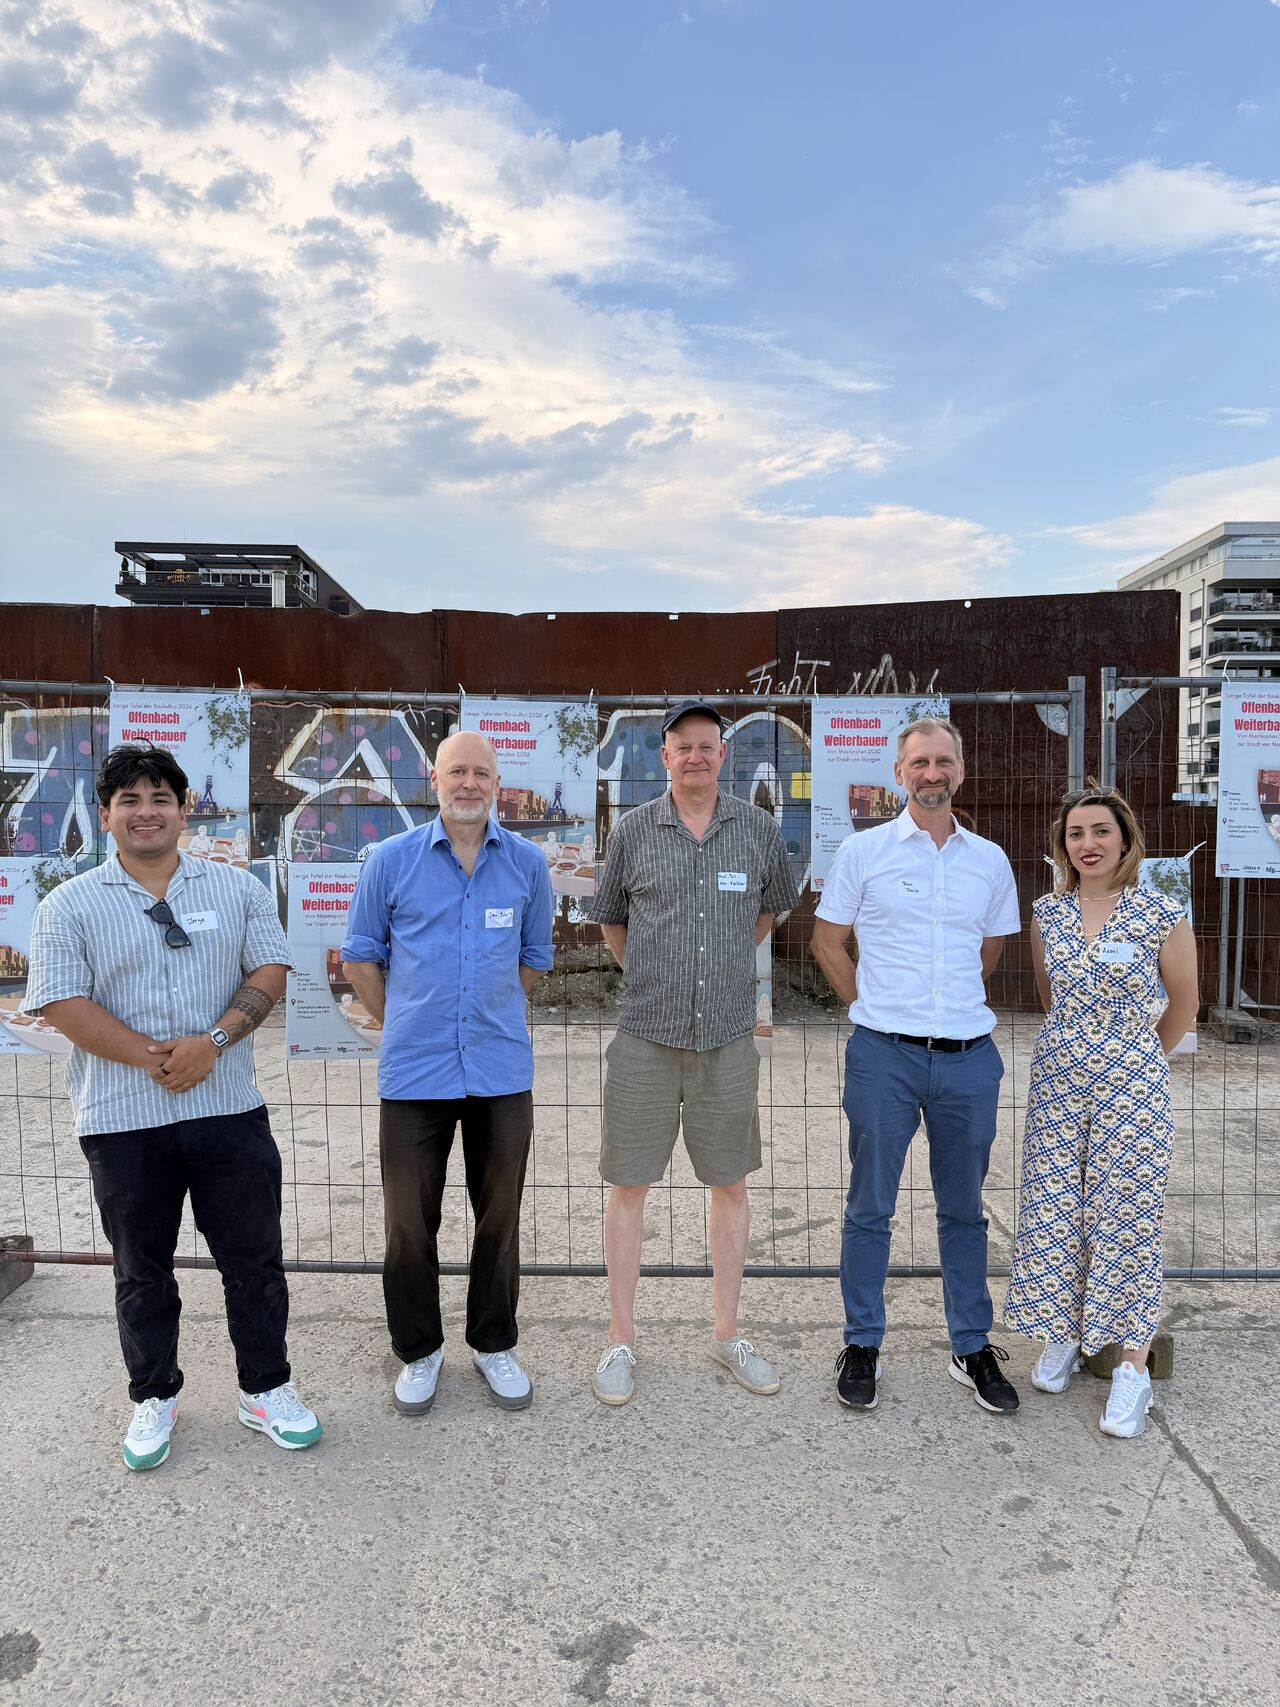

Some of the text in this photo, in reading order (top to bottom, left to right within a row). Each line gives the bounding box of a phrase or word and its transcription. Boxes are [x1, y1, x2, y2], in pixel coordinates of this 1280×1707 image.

[128, 711, 180, 724] Offenbach
[830, 717, 881, 729] Offenbach
[480, 719, 530, 732] Offenbach
[121, 728, 187, 742] Weiterbauen
[824, 734, 888, 747] Weiterbauen
[302, 898, 351, 911] Weiterba
